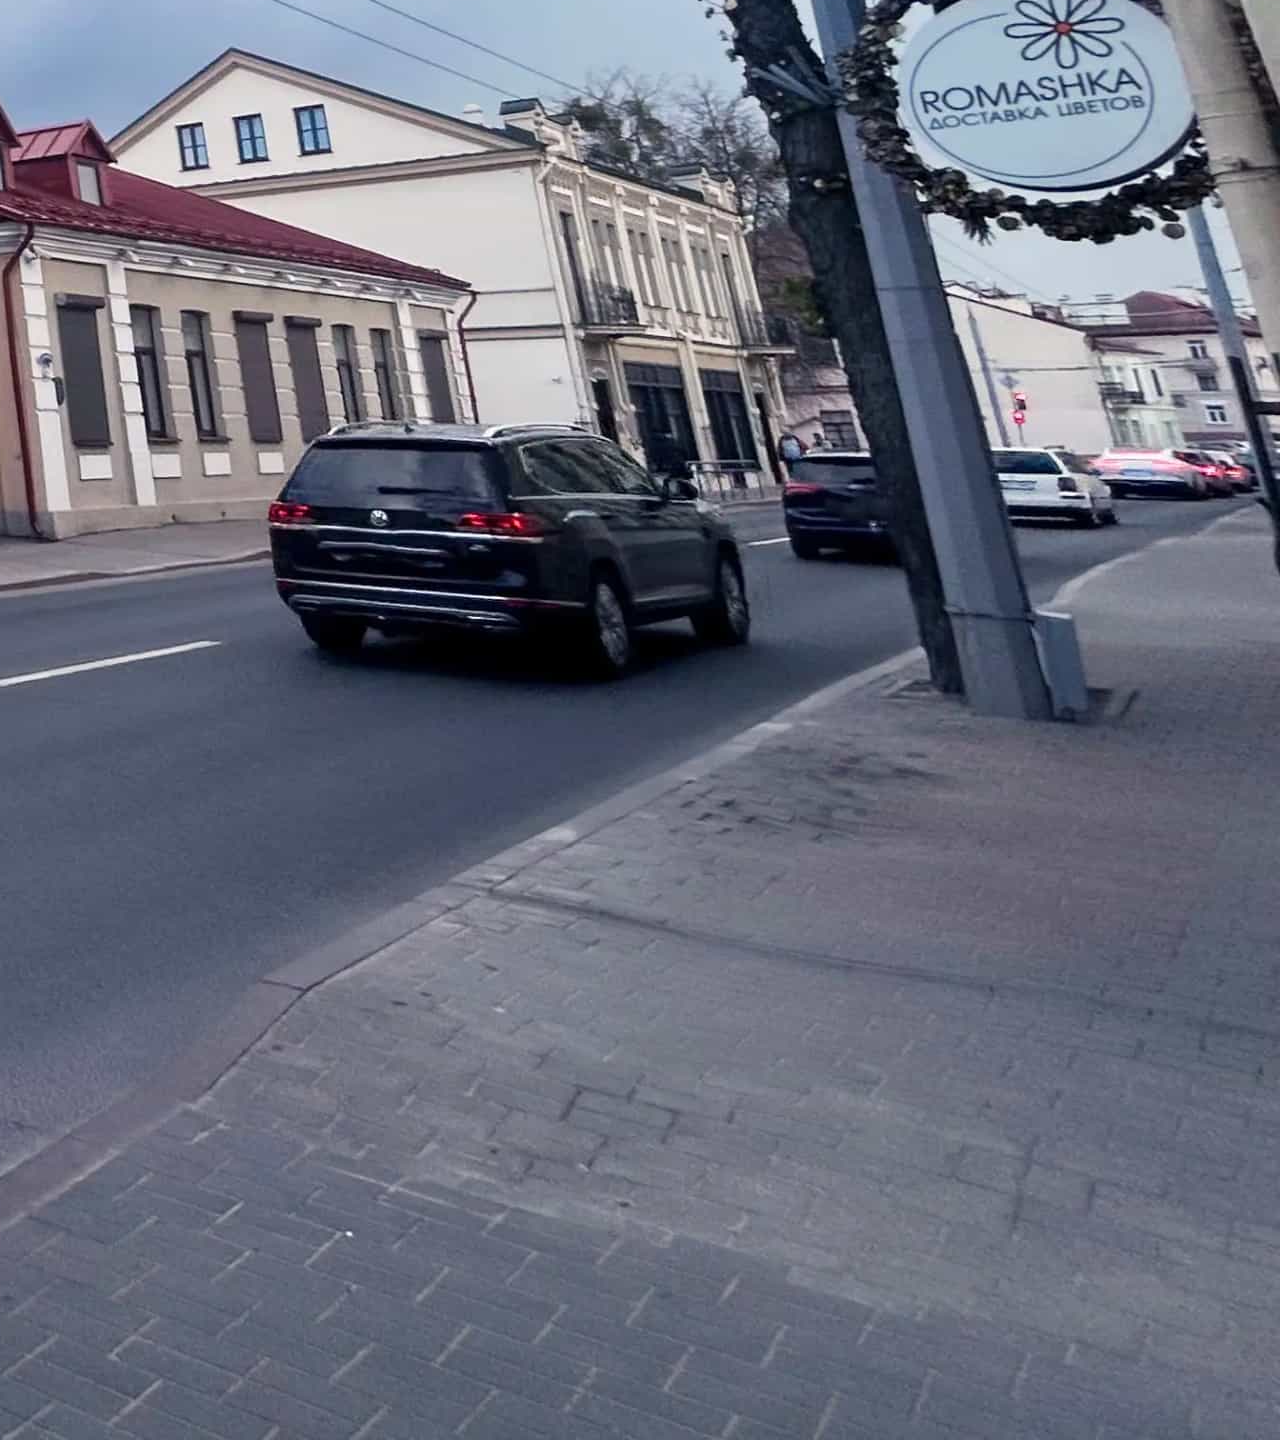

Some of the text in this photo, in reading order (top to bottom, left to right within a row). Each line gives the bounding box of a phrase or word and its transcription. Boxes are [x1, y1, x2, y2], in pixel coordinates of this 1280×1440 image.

[920, 67, 1143, 113] ROMASHKA
[929, 95, 1146, 130] ДОСТАВКА ЦВЕТОВ
